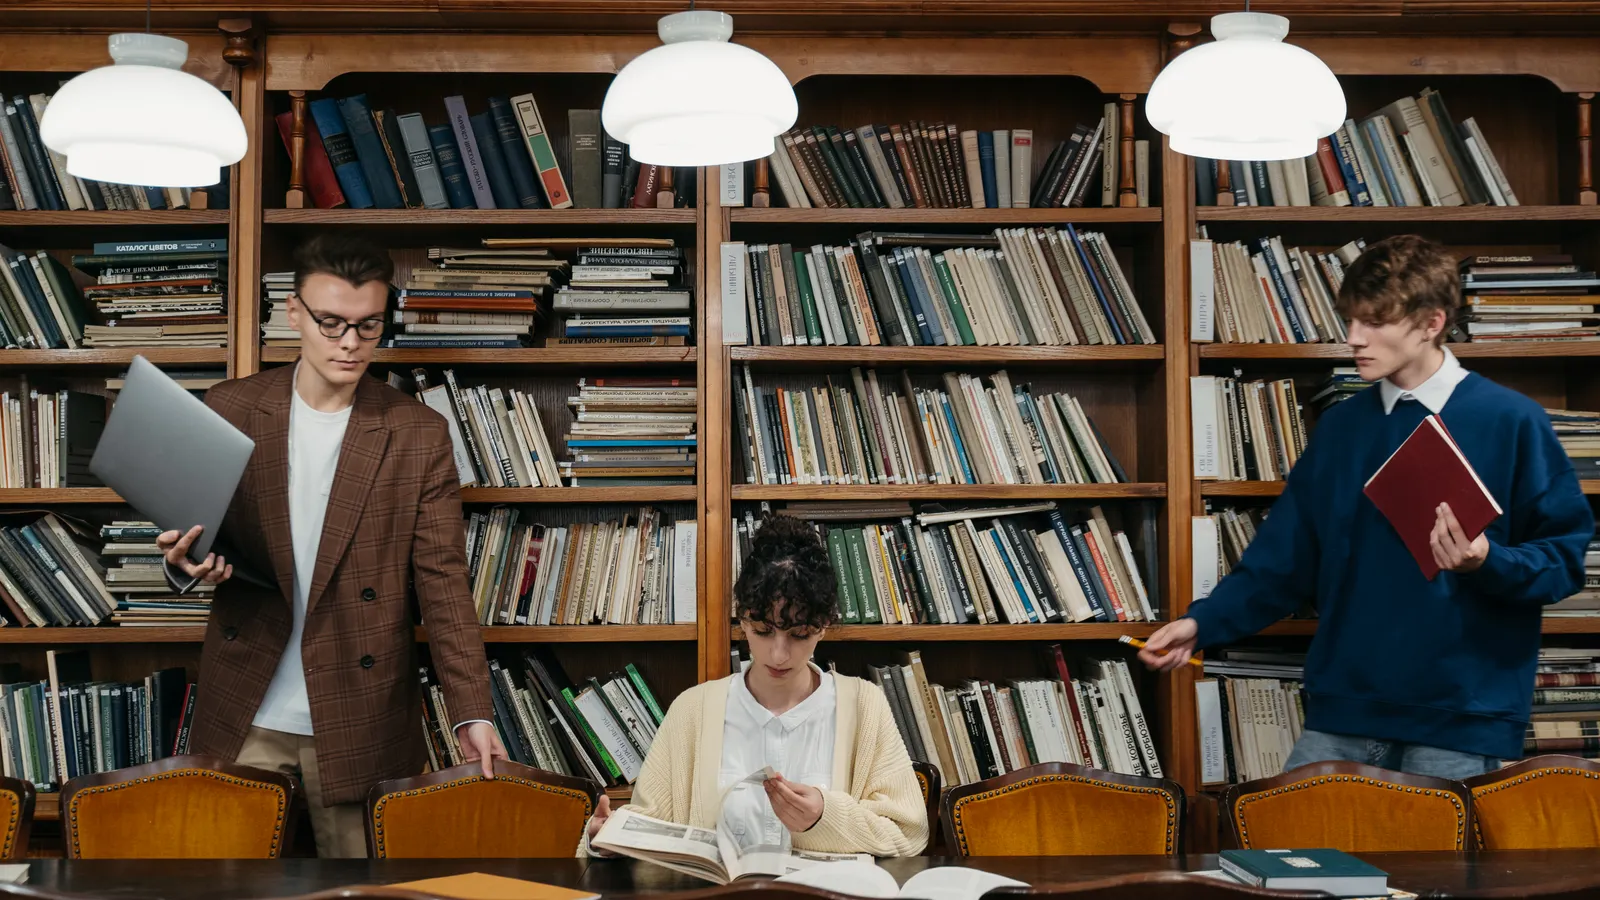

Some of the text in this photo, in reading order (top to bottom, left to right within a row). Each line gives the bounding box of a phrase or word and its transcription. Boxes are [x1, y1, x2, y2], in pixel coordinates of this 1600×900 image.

[1017, 544, 1029, 564] РУССКОЙ
[1025, 564, 1043, 594] АРХИТЕКТУРЫ
[1056, 520, 1098, 607] СТРОИТЕЛЬНЫЕ КОНСТРУКЦИИ
[47, 696, 57, 735] ДВИЖЕНИ
[1119, 712, 1141, 774] ЛЕ КОРБЮЗЬЕ
[1134, 712, 1158, 774] ЛЕ КОРБЮЗЬЕ
